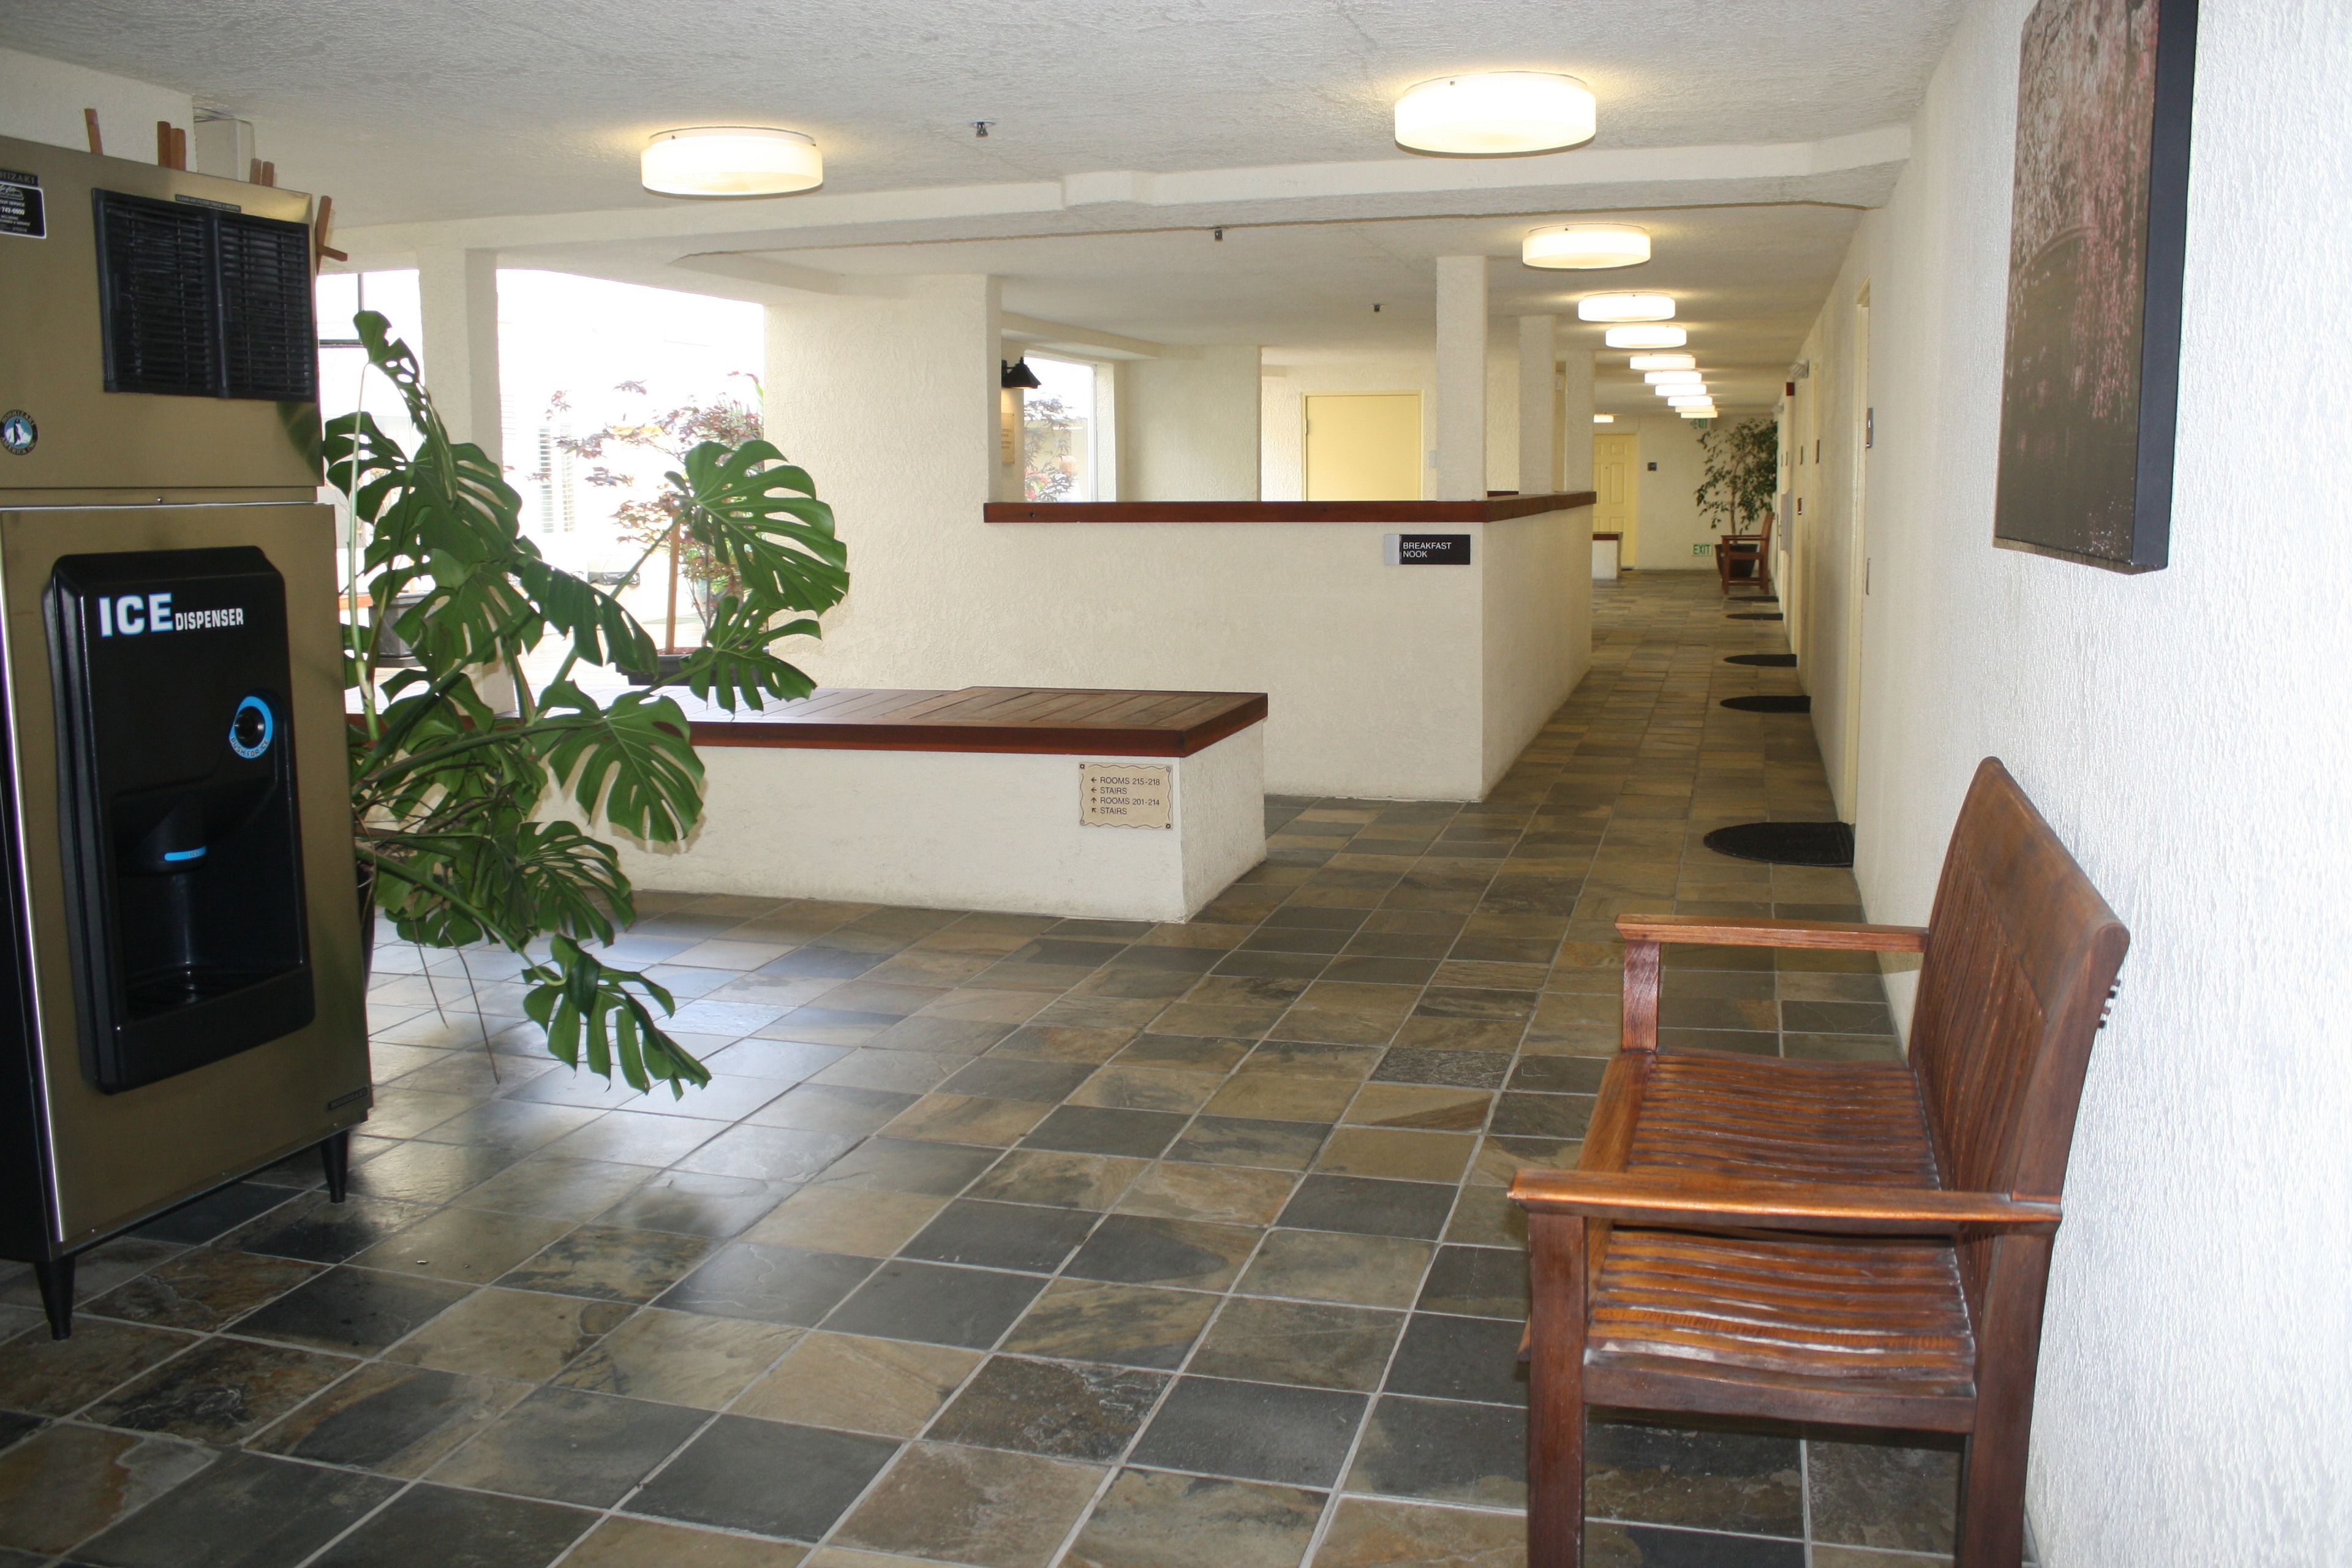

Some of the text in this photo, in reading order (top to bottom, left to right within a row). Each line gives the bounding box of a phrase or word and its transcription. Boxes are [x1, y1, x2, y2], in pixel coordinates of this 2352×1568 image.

[1403, 541, 1452, 550] BREAKFAST
[1693, 544, 1711, 555] EXIT
[99, 592, 244, 638] ICE DISPENSER
[230, 737, 246, 755] PUSH
[260, 739, 270, 751] ICE
[1100, 776, 1130, 785] ROOMS
